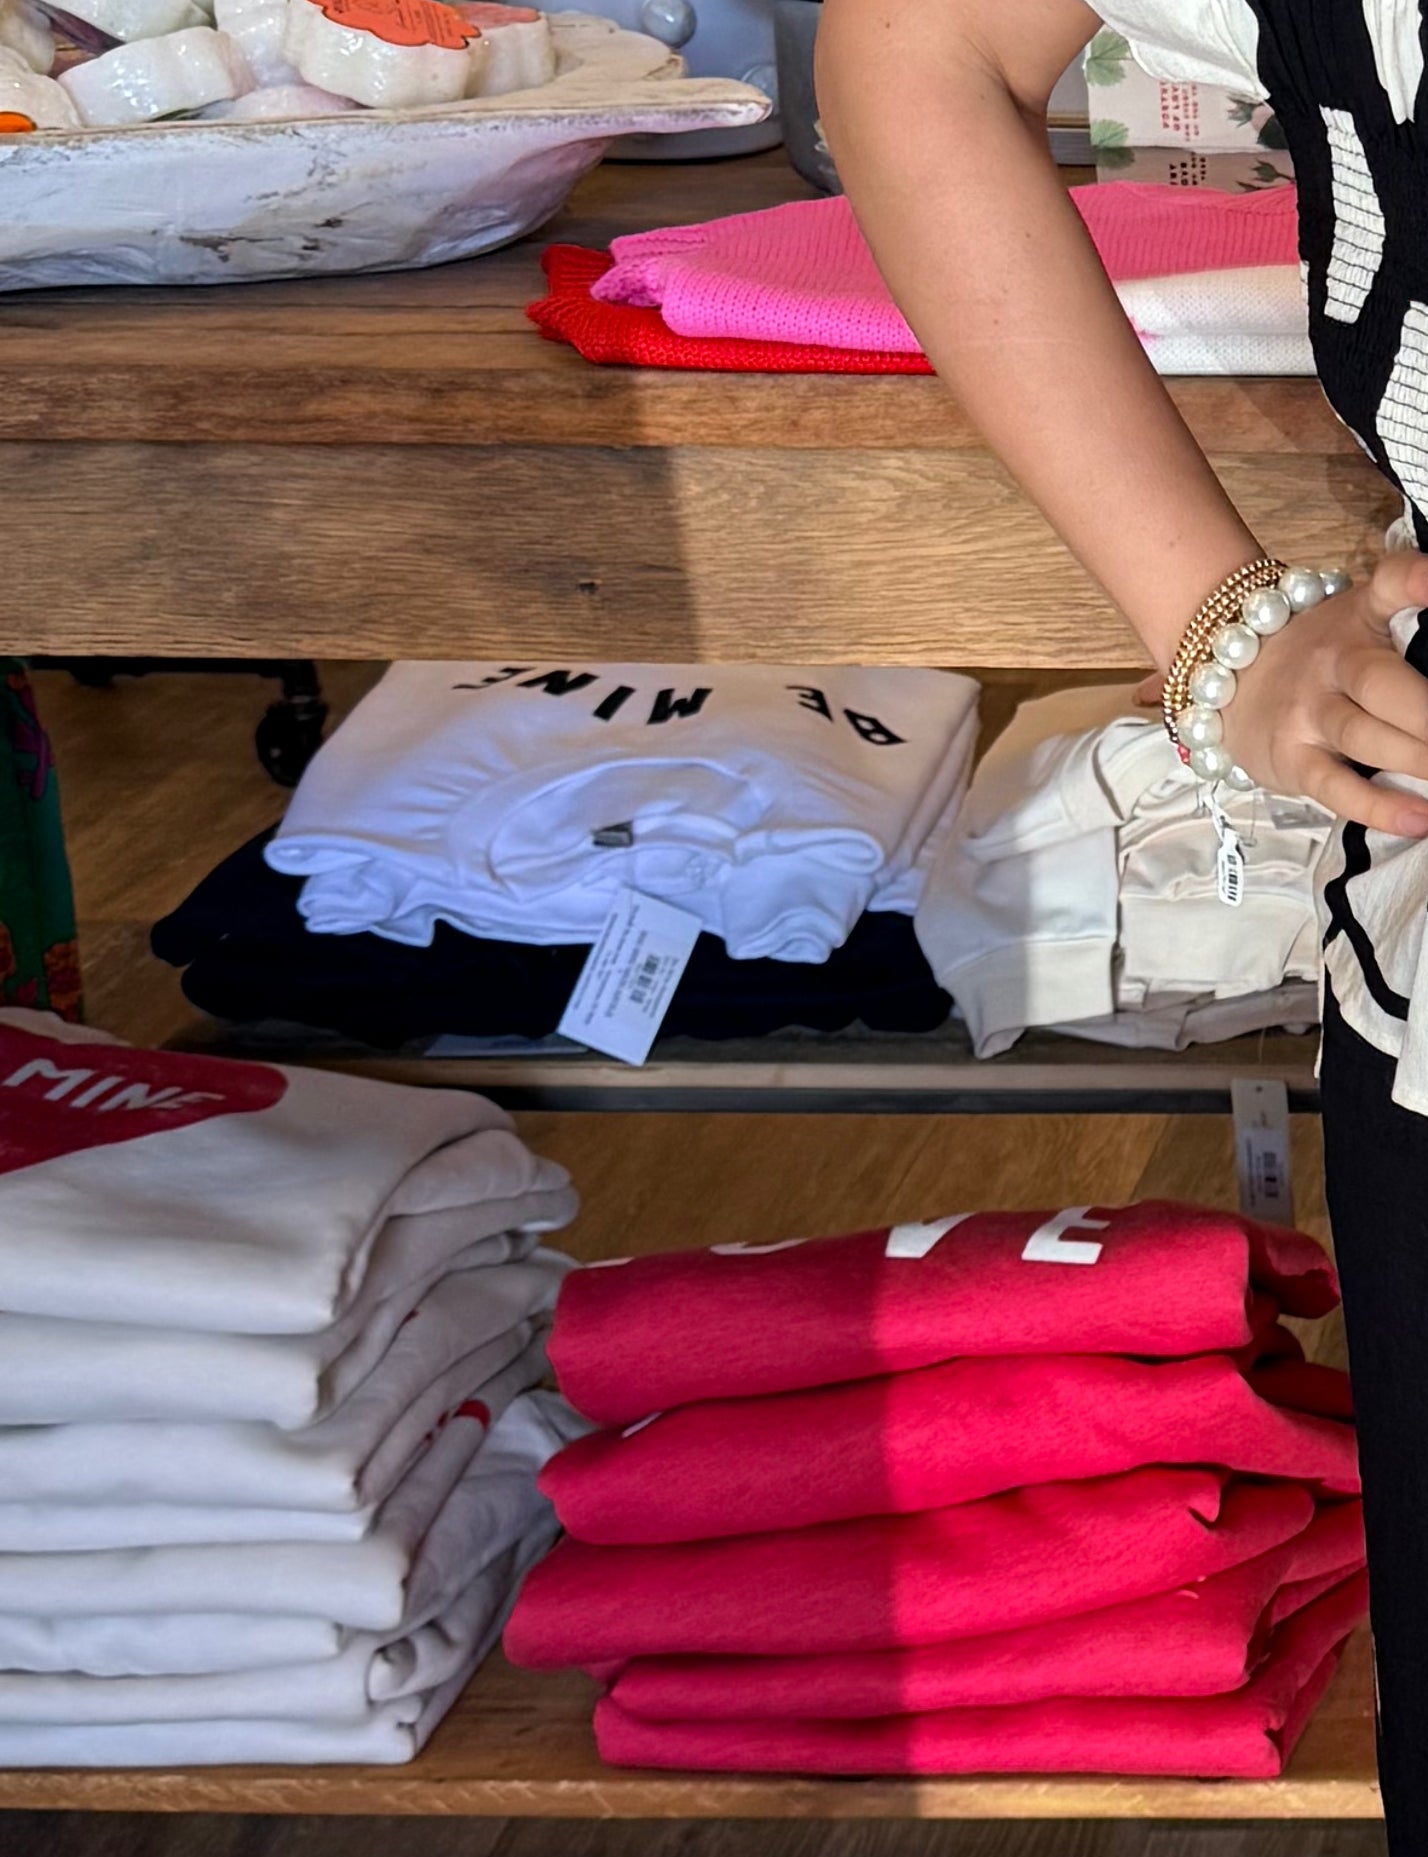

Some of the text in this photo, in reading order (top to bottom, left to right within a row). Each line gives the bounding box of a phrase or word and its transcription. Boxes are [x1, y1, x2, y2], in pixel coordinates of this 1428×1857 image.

[452, 667, 910, 746] BE MINE
[2, 1058, 227, 1112] MINE
